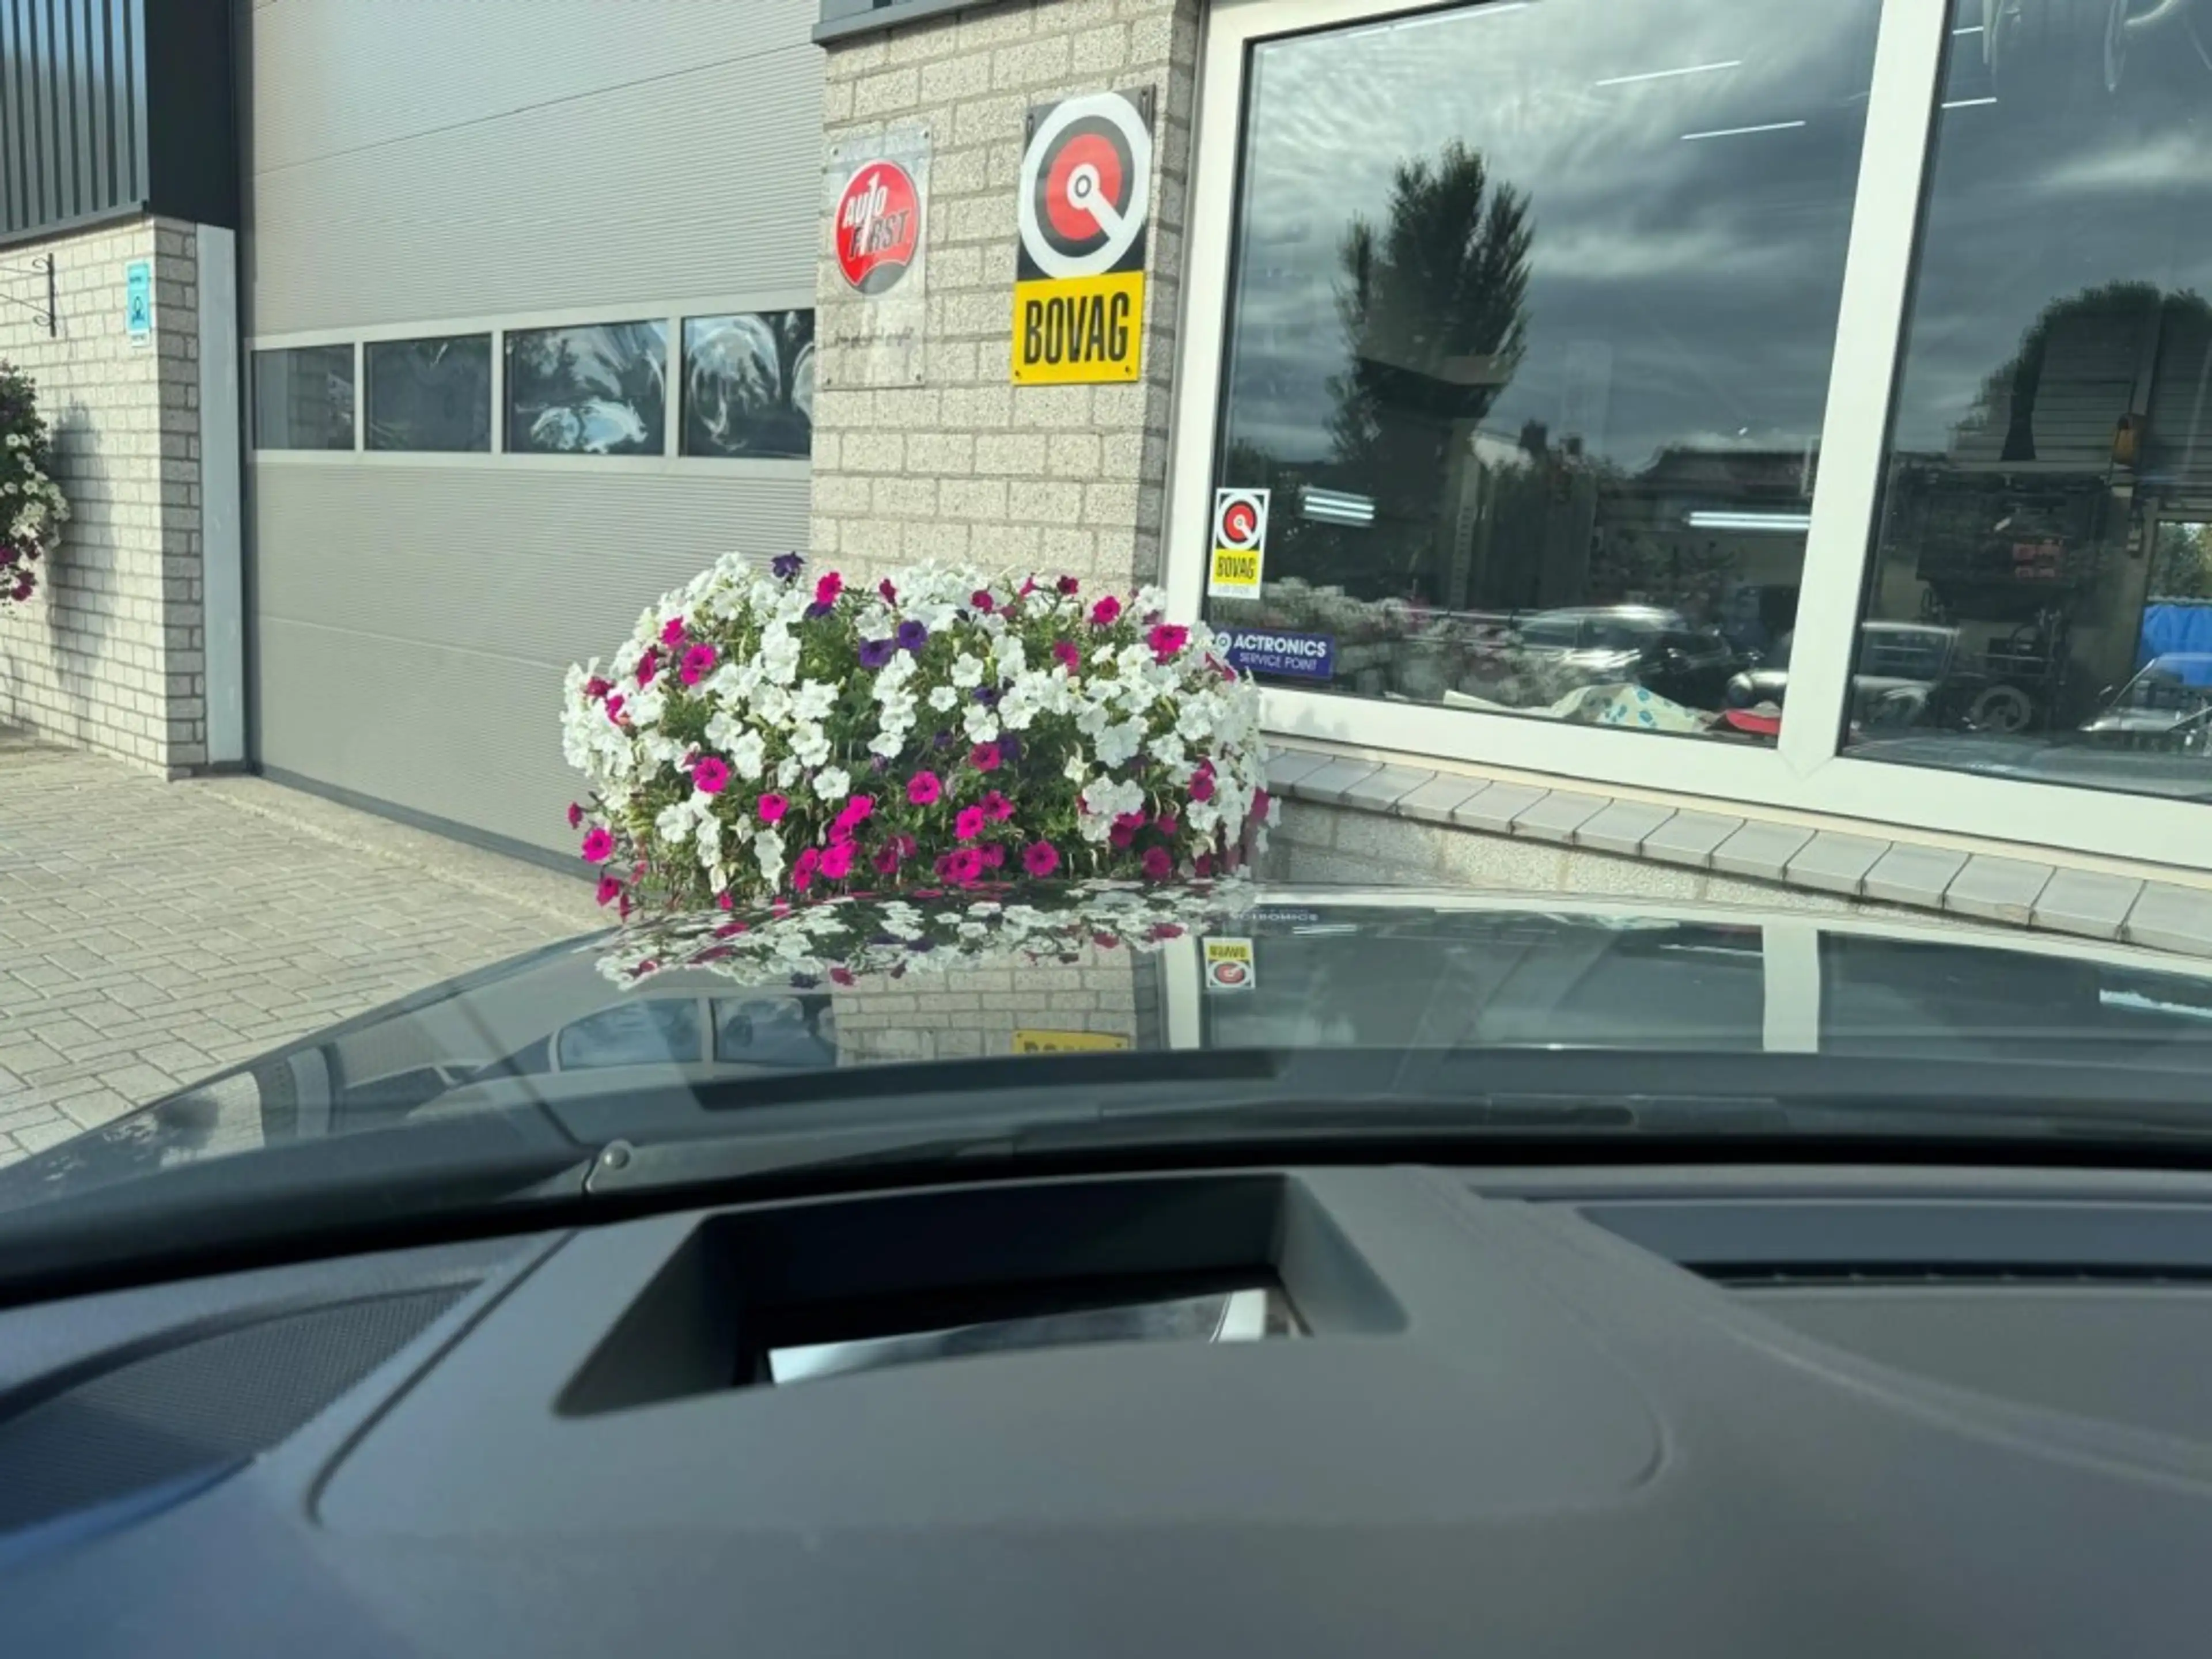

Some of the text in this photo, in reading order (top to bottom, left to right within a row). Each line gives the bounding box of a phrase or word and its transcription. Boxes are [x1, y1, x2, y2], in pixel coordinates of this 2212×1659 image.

[1024, 291, 1129, 365] BOVAG
[1216, 556, 1256, 579] BOVAG
[1234, 635, 1327, 657] ACTRONICS
[1240, 652, 1317, 671] SERVICE POINT
